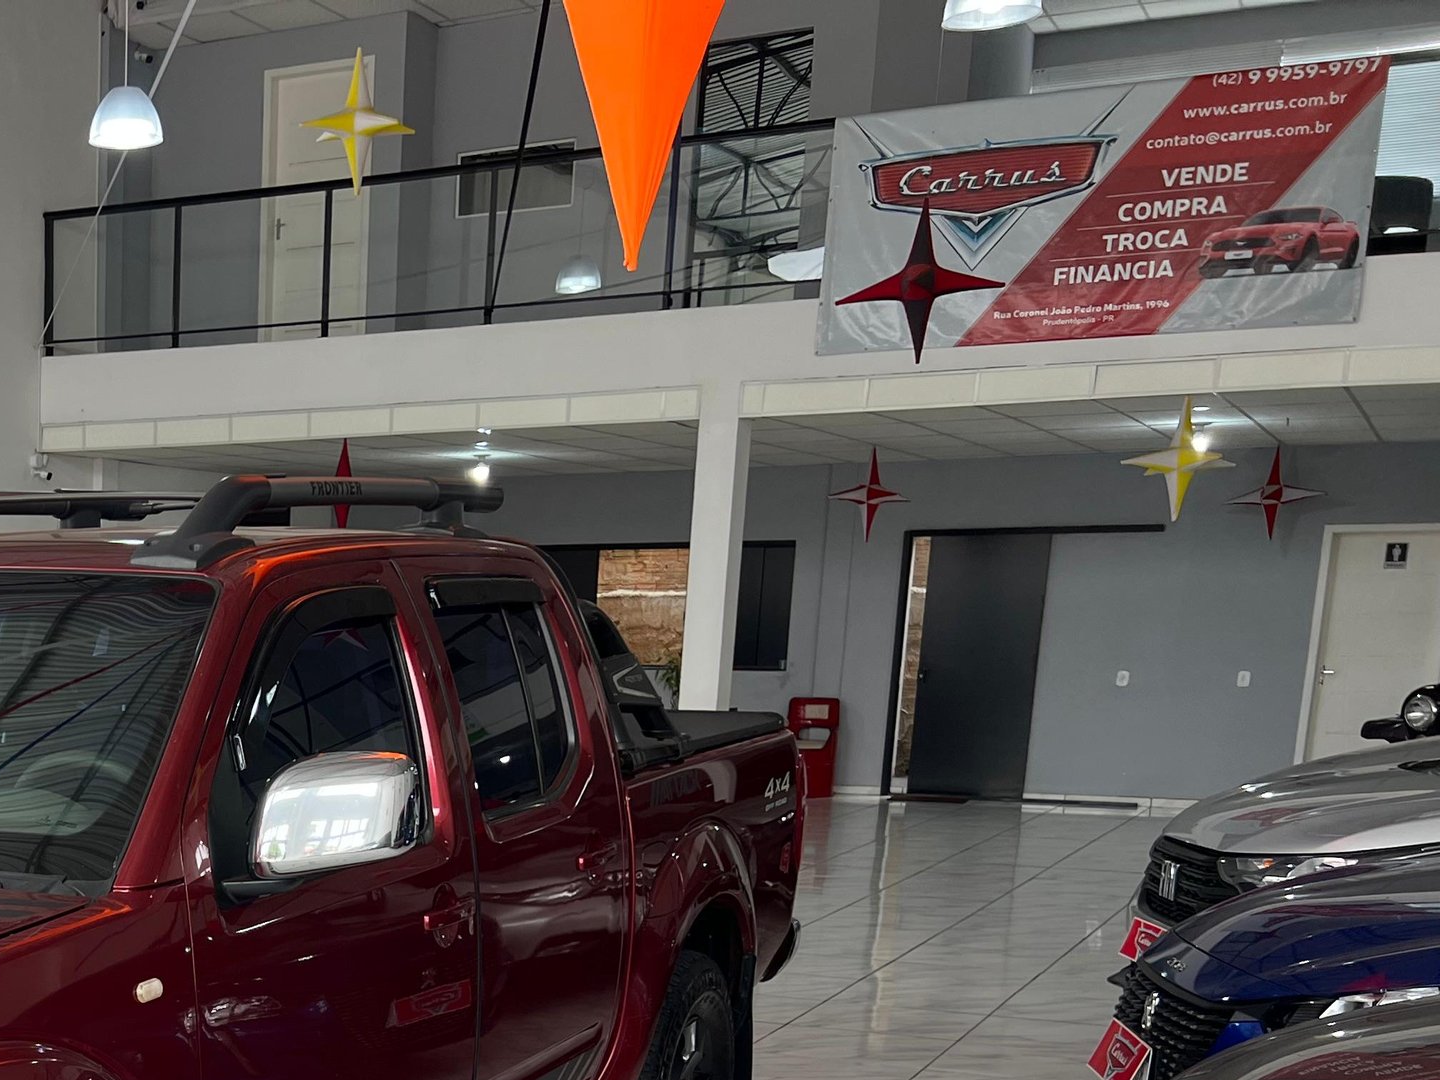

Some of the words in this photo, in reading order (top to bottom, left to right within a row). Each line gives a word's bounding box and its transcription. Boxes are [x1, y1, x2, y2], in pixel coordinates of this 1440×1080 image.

[1212, 71, 1243, 88] (42)
[1248, 69, 1261, 85] 9
[1266, 56, 1383, 83] 9959-9797
[1183, 91, 1348, 120] www.carrus.com.br
[1146, 120, 1333, 150] contato@carrus.com.br
[898, 160, 1067, 197] Carrus
[1161, 161, 1250, 188] VENDE
[1117, 195, 1228, 222] COMPRA
[1101, 228, 1189, 253] TROCA
[1052, 259, 1174, 286] FINANCIA
[993, 310, 1011, 320] Rua
[1013, 308, 1049, 319] Coronel
[1050, 306, 1073, 317] João
[1074, 304, 1102, 315] Pedro
[1103, 302, 1143, 314] Martins,
[1145, 300, 1170, 310] 1996
[1102, 315, 1115, 323] PR
[309, 480, 363, 497] FRONTIER
[764, 770, 791, 799] 4x4
